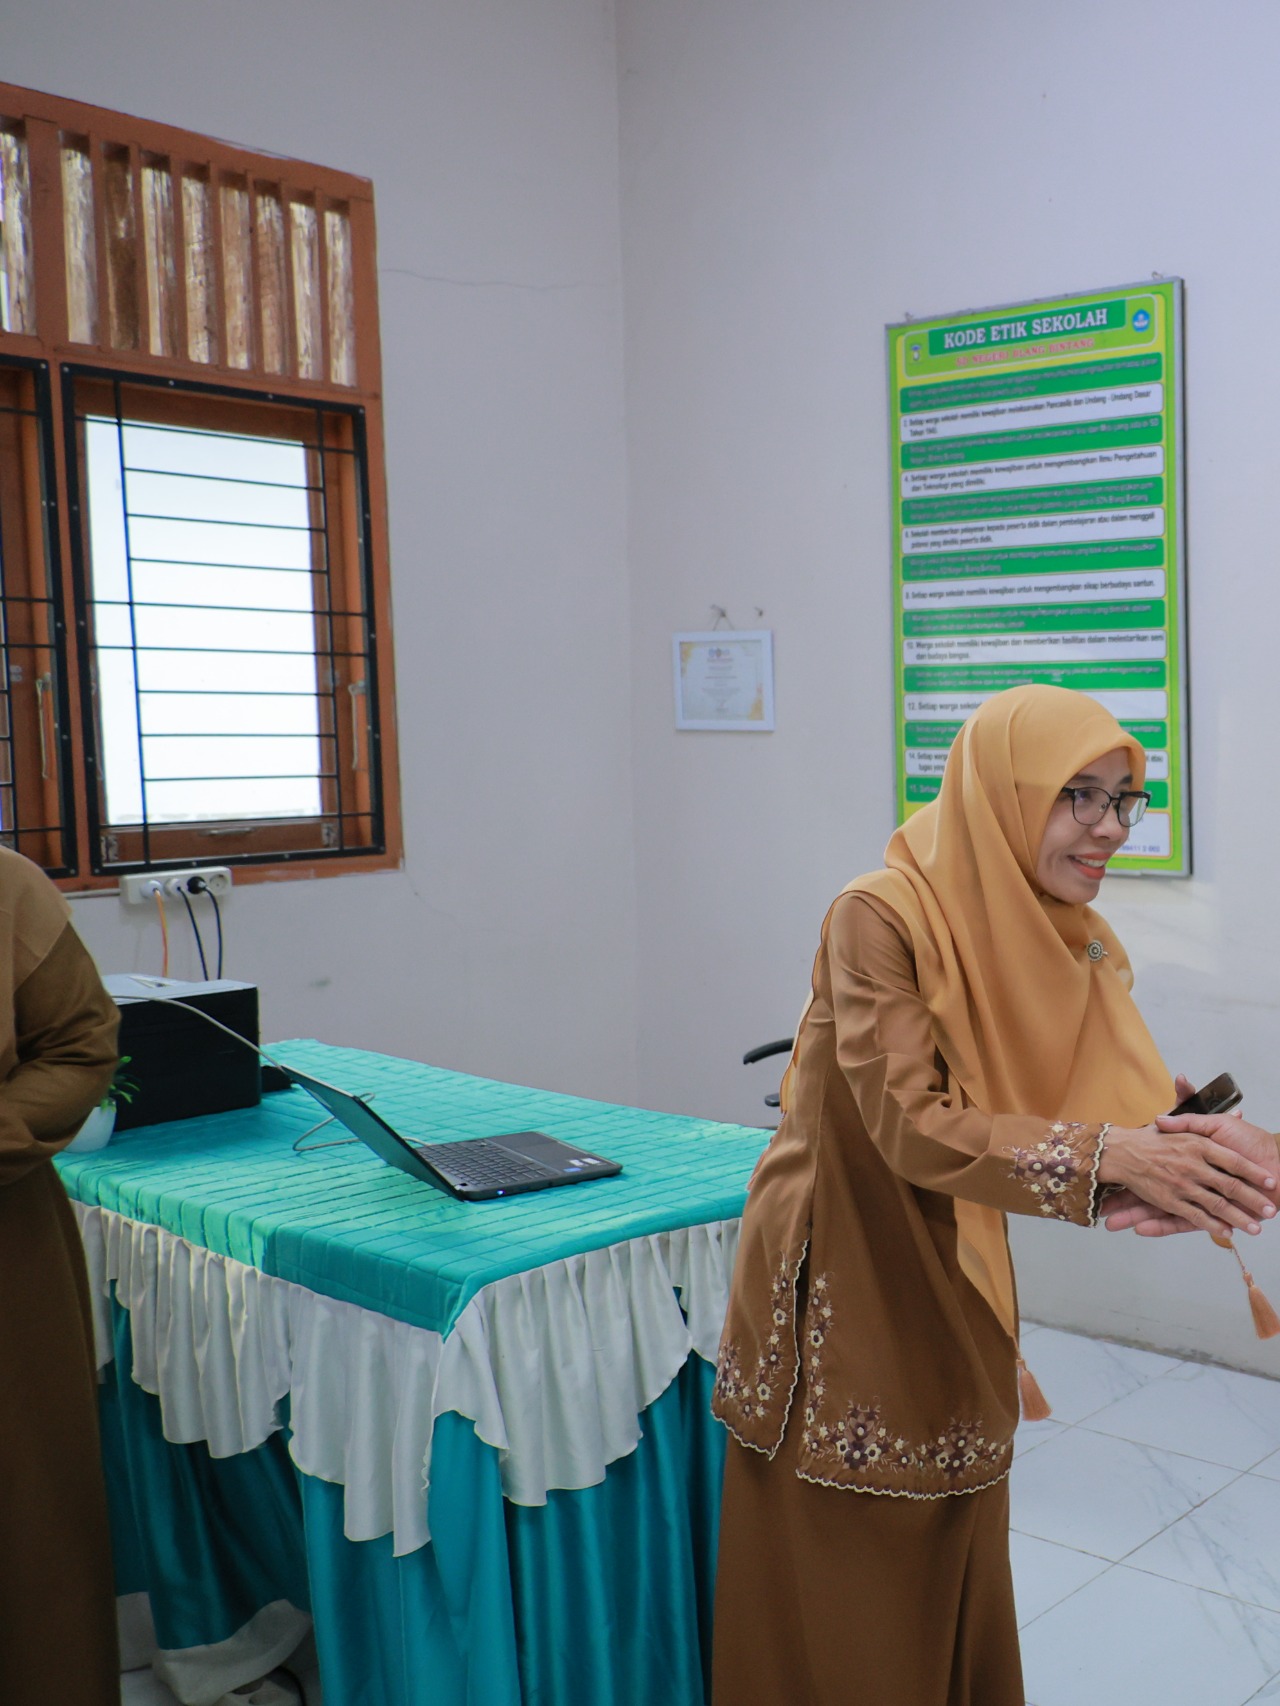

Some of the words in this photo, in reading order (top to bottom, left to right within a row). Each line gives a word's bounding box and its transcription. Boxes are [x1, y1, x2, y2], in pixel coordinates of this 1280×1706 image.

[944, 327, 986, 348] KODE
[991, 321, 1028, 342] ETIK
[1033, 308, 1108, 336] SEKOLAH
[1013, 345, 1045, 358] BLANG
[1048, 338, 1095, 353] BINTANG
